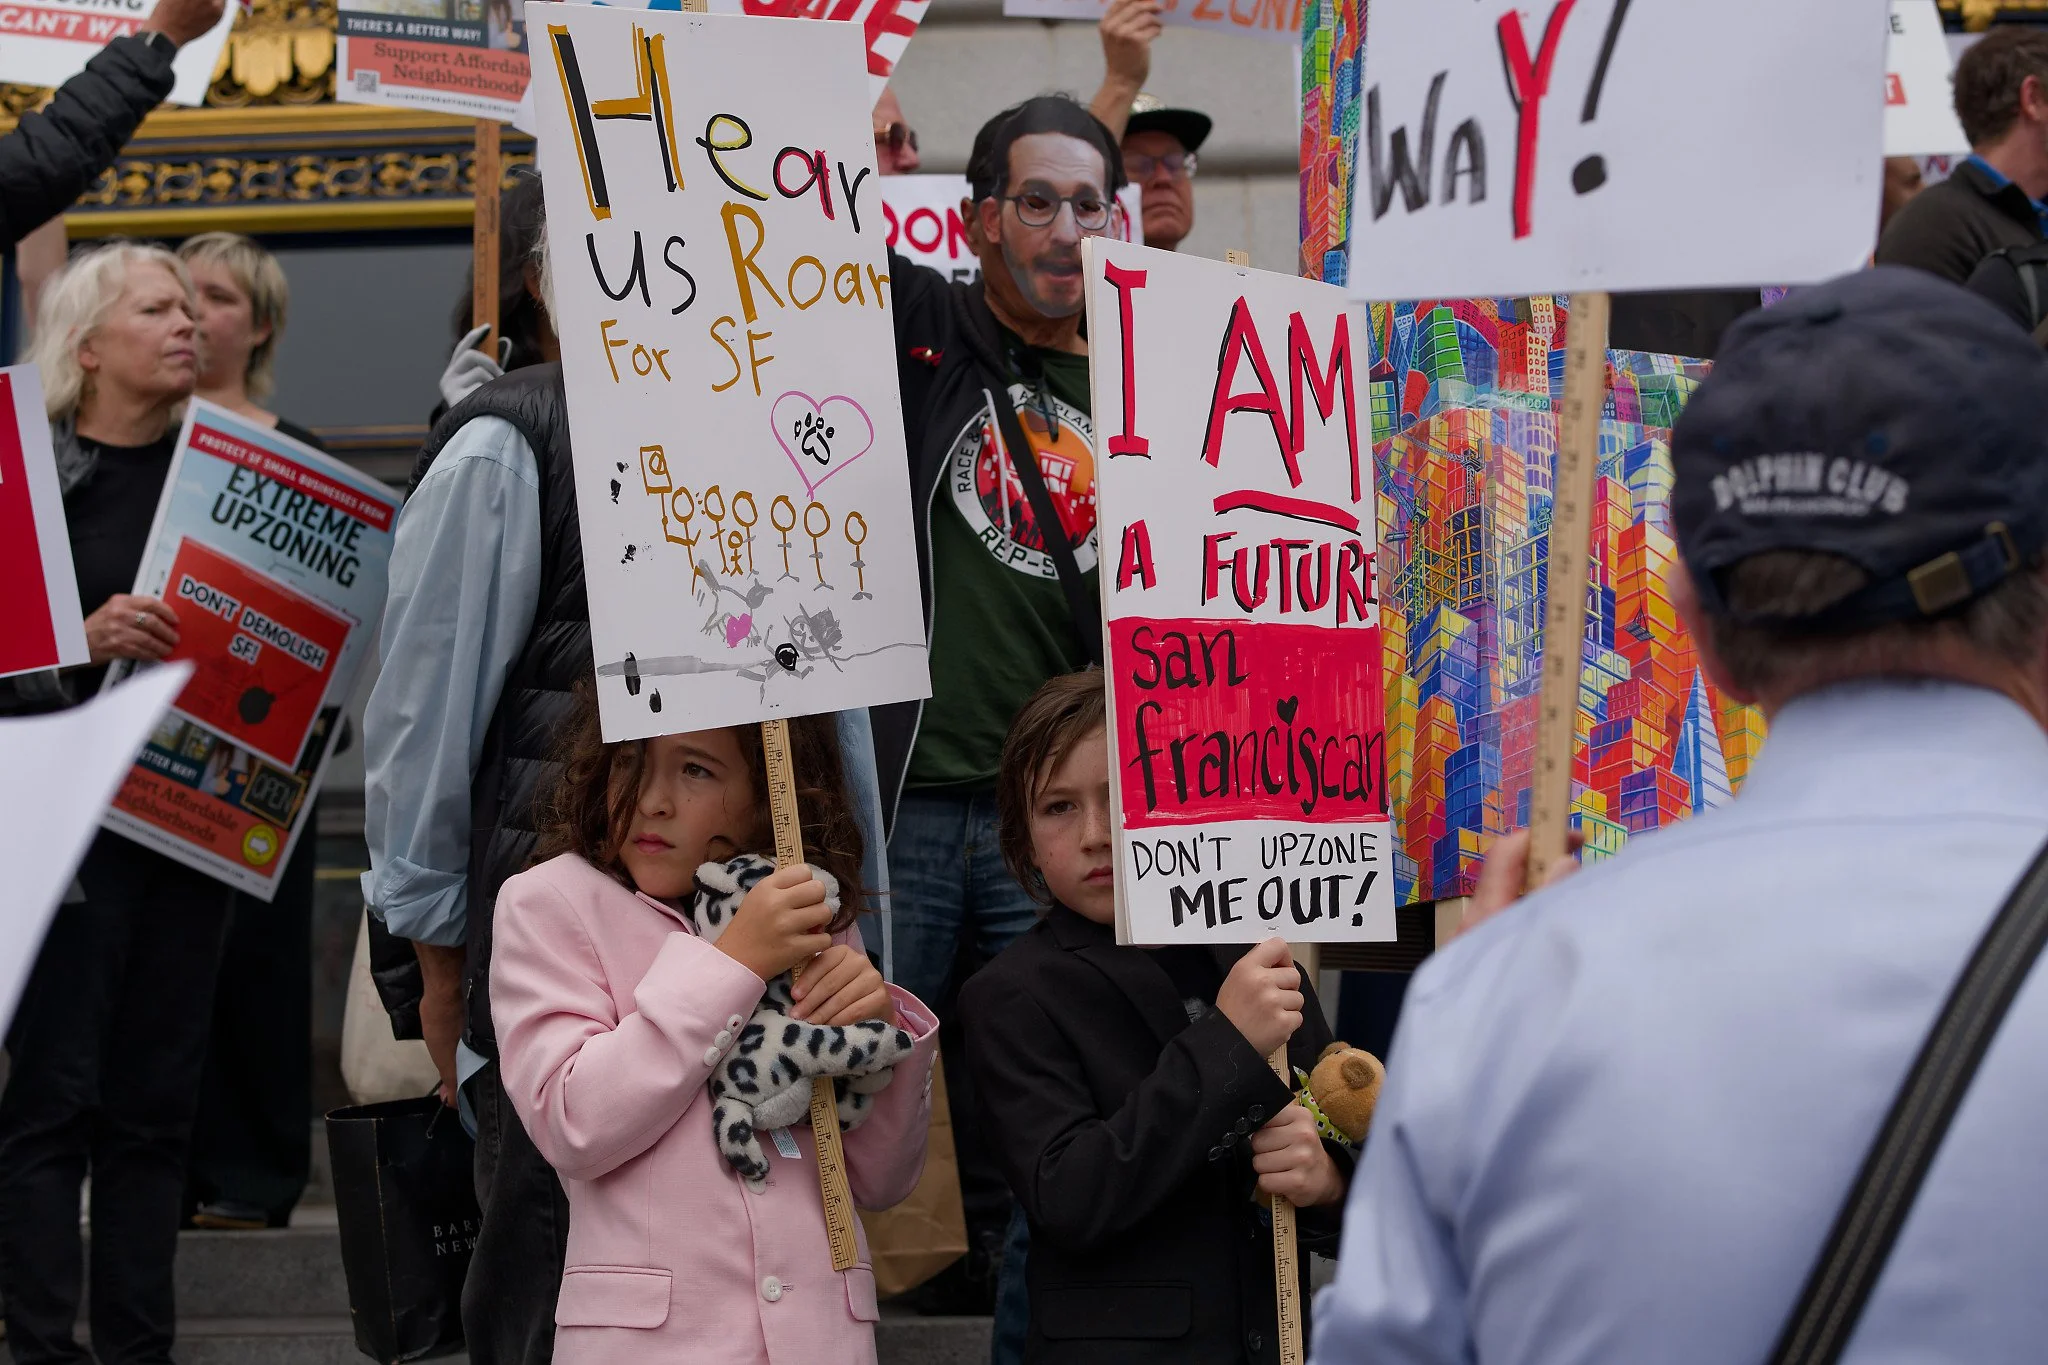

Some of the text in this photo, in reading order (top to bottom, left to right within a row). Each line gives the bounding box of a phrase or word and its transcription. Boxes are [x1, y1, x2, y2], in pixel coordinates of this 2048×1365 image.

[0, 8, 82, 37] CAN'T
[346, 17, 393, 34] THERE'S
[395, 22, 406, 33] A
[407, 23, 449, 38] BETTER
[374, 41, 449, 64] Support
[547, 23, 870, 234] Hear
[720, 201, 890, 324] Roar
[600, 315, 775, 397] For SF
[1104, 258, 1362, 504] I AM
[198, 432, 247, 459] PROTECT
[263, 457, 297, 482] SMALL
[299, 472, 359, 508] BUSINESSES
[357, 498, 387, 522] FROM
[227, 464, 367, 552] EXTREME
[958, 447, 975, 493] RACE
[1711, 452, 1910, 513] DOLPHIN CLUB
[211, 492, 361, 589] UPZONING
[1116, 519, 1378, 628] A FUTURE
[180, 577, 240, 619] DON'T
[241, 610, 327, 669] DEMOLISH
[1132, 626, 1251, 690] san
[252, 773, 297, 813] OPEN
[1128, 696, 1389, 815] franciscan
[1132, 832, 1378, 881] DON'T UPZONE
[1169, 871, 1378, 929] ME OUT!
